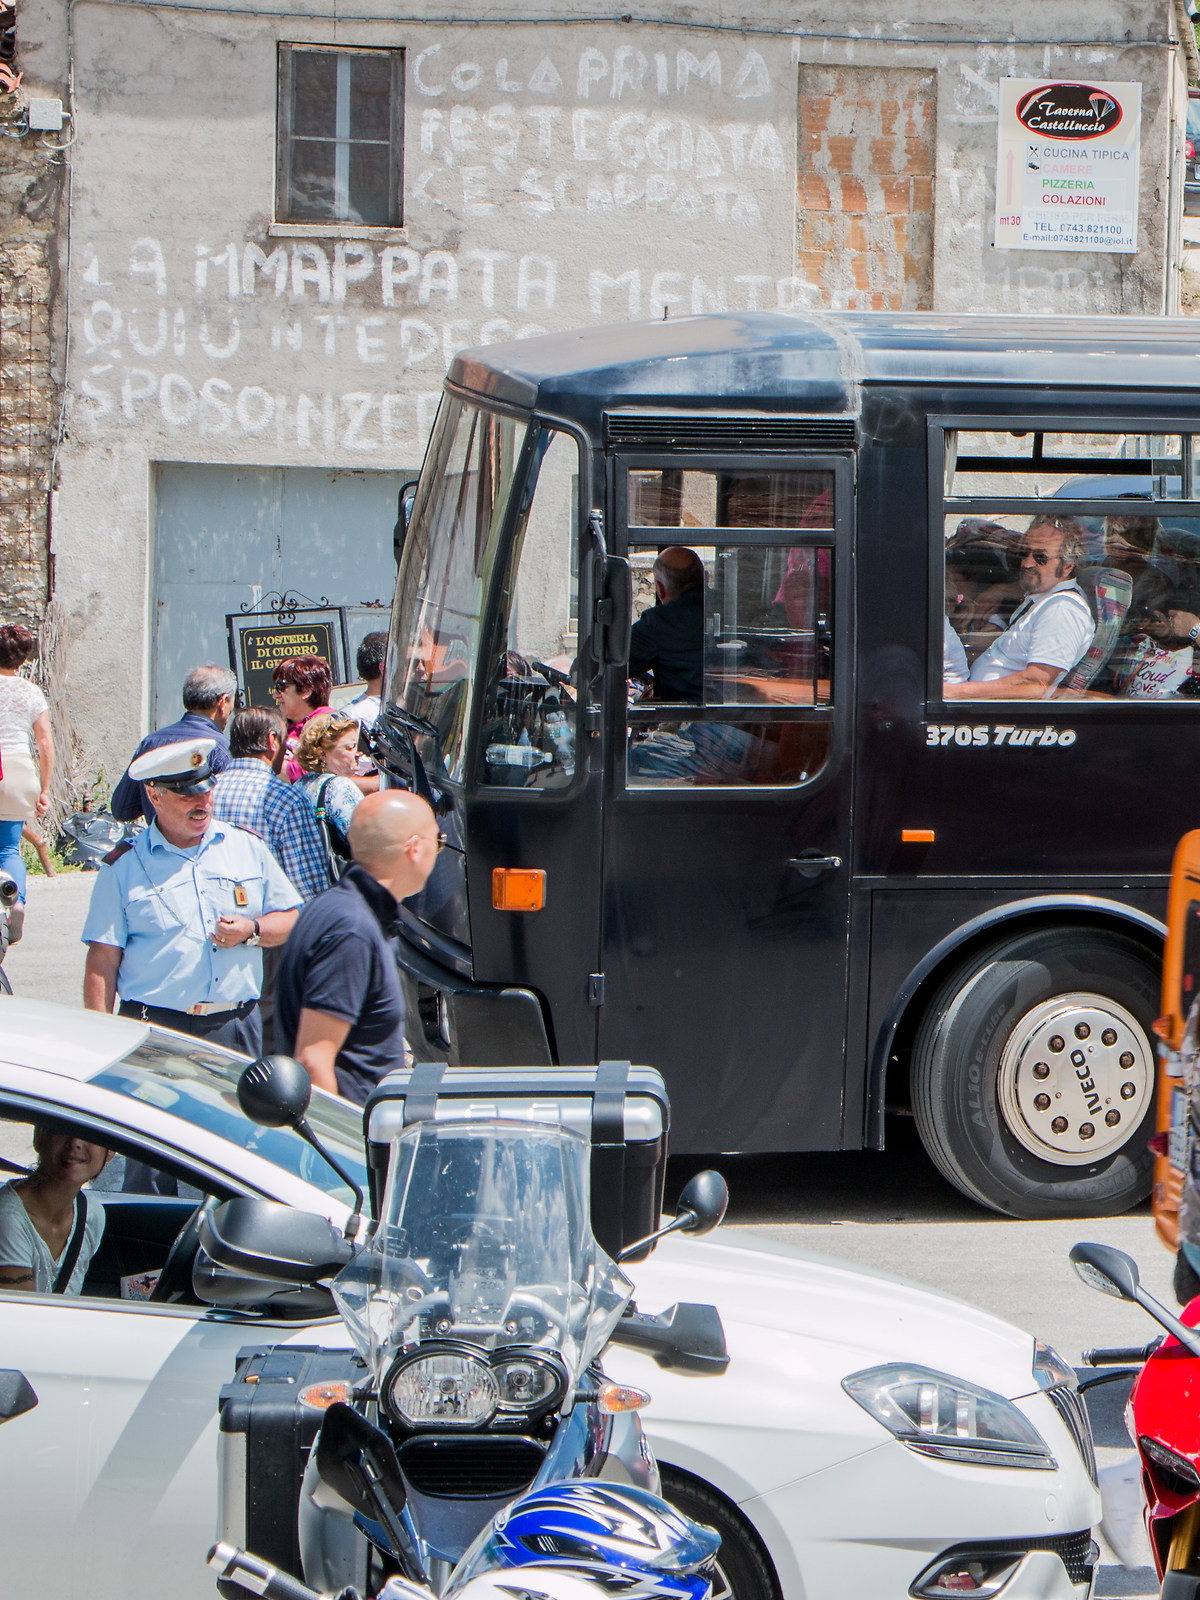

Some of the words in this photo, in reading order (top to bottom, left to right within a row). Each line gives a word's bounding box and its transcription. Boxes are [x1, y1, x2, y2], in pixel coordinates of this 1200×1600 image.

[1038, 102, 1094, 118] Taverna
[1027, 115, 1106, 132] Castelluccio
[1043, 148, 1088, 159] CUCINA
[1092, 150, 1130, 161] TIPICA
[1043, 164, 1094, 175] CAMERE
[1042, 179, 1095, 190] PIZZERIA
[1042, 194, 1106, 206] COLAZIONI
[1034, 222, 1057, 232] TEL.
[1060, 223, 1122, 234] 0743.821100
[255, 633, 318, 646] L'OSTERIA
[257, 648, 271, 658] DI
[272, 645, 318, 657] CIORRO
[251, 660, 263, 670] IL
[926, 725, 989, 746] 370S
[993, 725, 1077, 746] Turbo
[1069, 1049, 1103, 1116] IVECO
